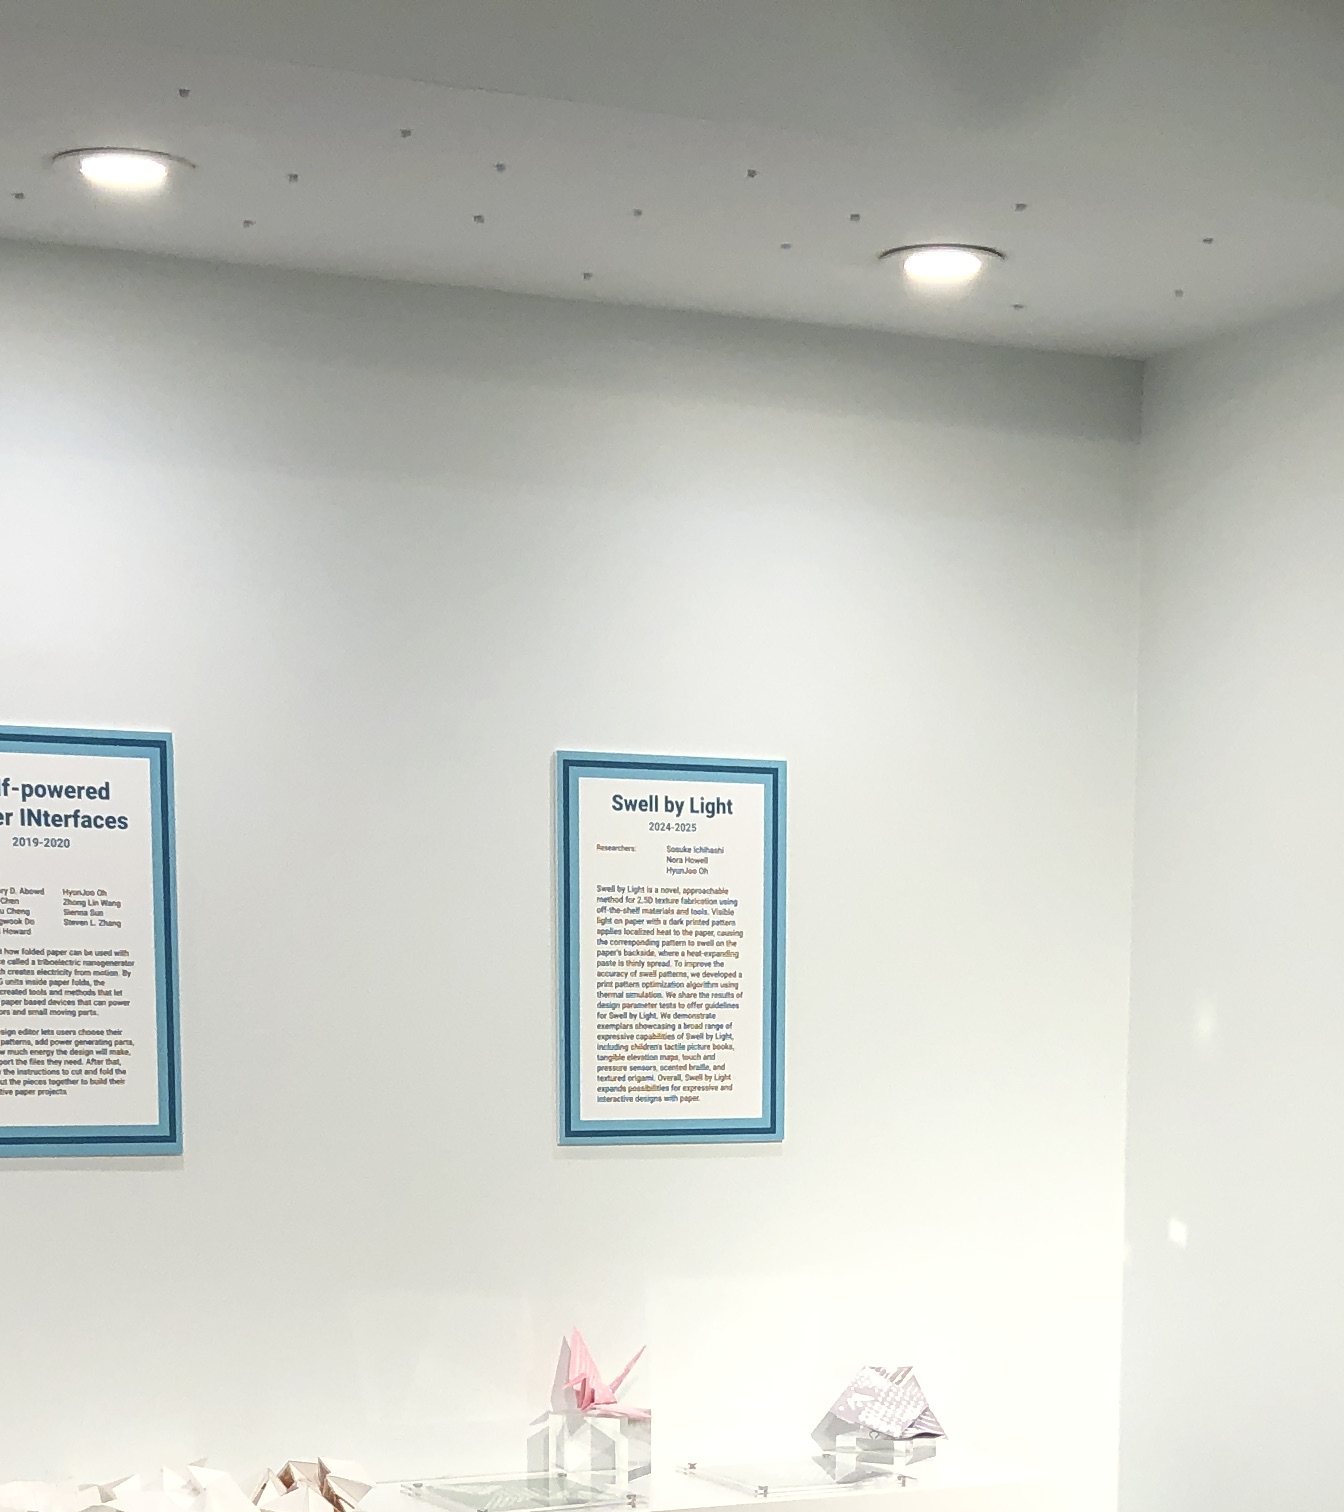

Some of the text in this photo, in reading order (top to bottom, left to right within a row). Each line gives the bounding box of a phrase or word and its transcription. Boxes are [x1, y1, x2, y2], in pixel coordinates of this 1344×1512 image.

[611, 794, 734, 819] Swell by Light
[20, 808, 129, 830] INterfaces
[648, 821, 696, 832] 2024-2025
[12, 837, 70, 848] 2019-2020
[596, 844, 636, 852] Researchers:
[666, 855, 708, 864] Nora Howell
[596, 884, 615, 892] Swell
[616, 885, 625, 894] by
[627, 885, 644, 895] Light
[646, 885, 652, 893] is
[660, 885, 680, 894] novel,
[682, 886, 728, 896] approachable
[62, 898, 86, 908] Zhong
[100, 899, 121, 909] Wang
[596, 895, 623, 903] method
[637, 896, 653, 904] 2.5D
[654, 896, 679, 904] texture
[680, 896, 717, 904] fabrication
[718, 897, 738, 906] using
[89, 909, 103, 917] Sun
[2, 927, 31, 935] Howard
[17, 1027, 39, 1035] editor
[40, 1027, 54, 1035] lets
